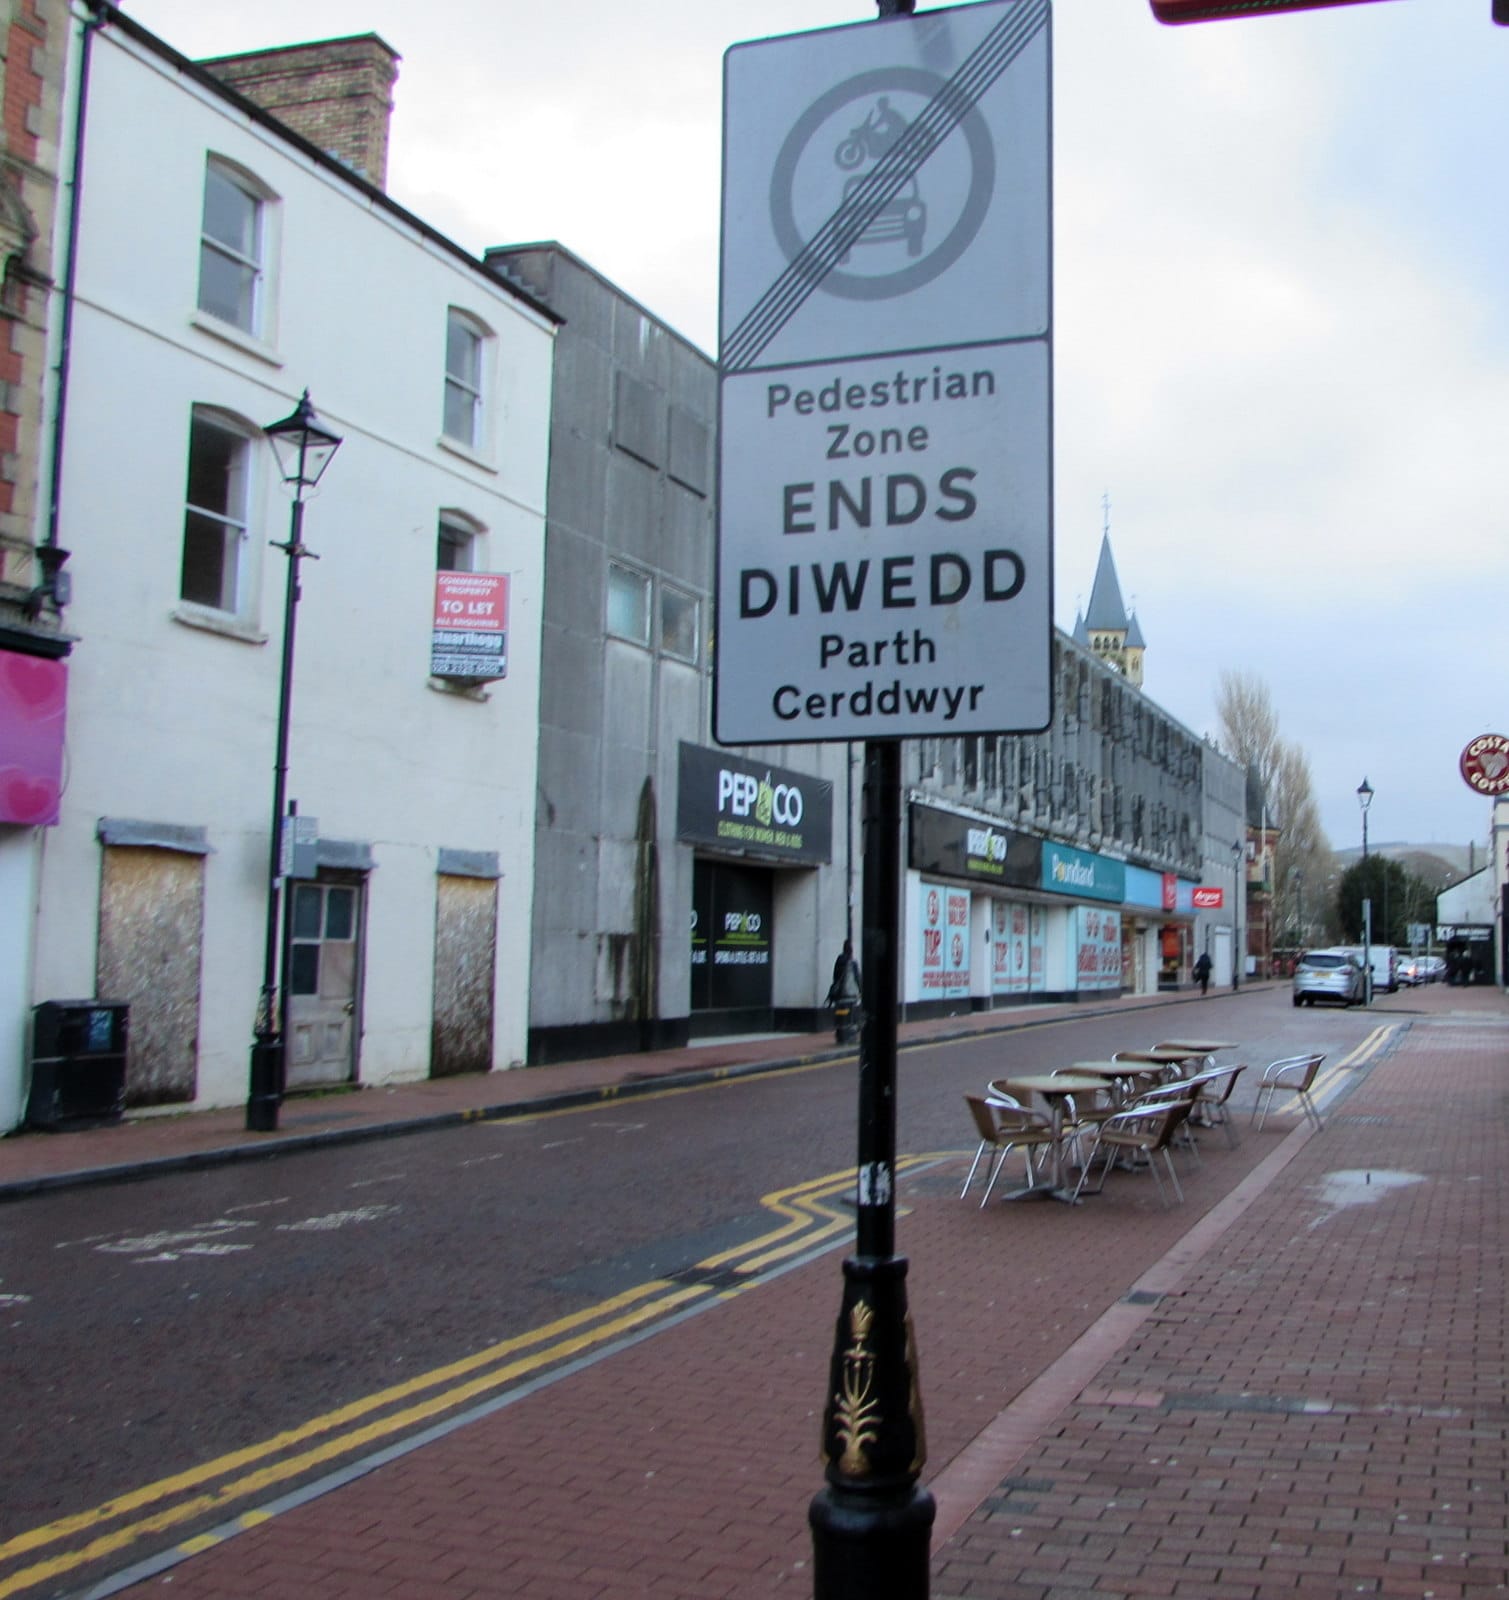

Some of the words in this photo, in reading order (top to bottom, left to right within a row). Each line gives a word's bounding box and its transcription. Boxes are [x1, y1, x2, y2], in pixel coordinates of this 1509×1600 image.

[768, 366, 995, 418] Pedestrian
[826, 424, 929, 459] Zone
[783, 467, 978, 535] ENDS
[739, 549, 1026, 619] DIWEDD
[441, 600, 464, 613] TO
[468, 601, 495, 615] LET
[819, 629, 936, 669] Parth
[773, 680, 985, 720] Cerddwyr
[1470, 737, 1509, 756] COSTA
